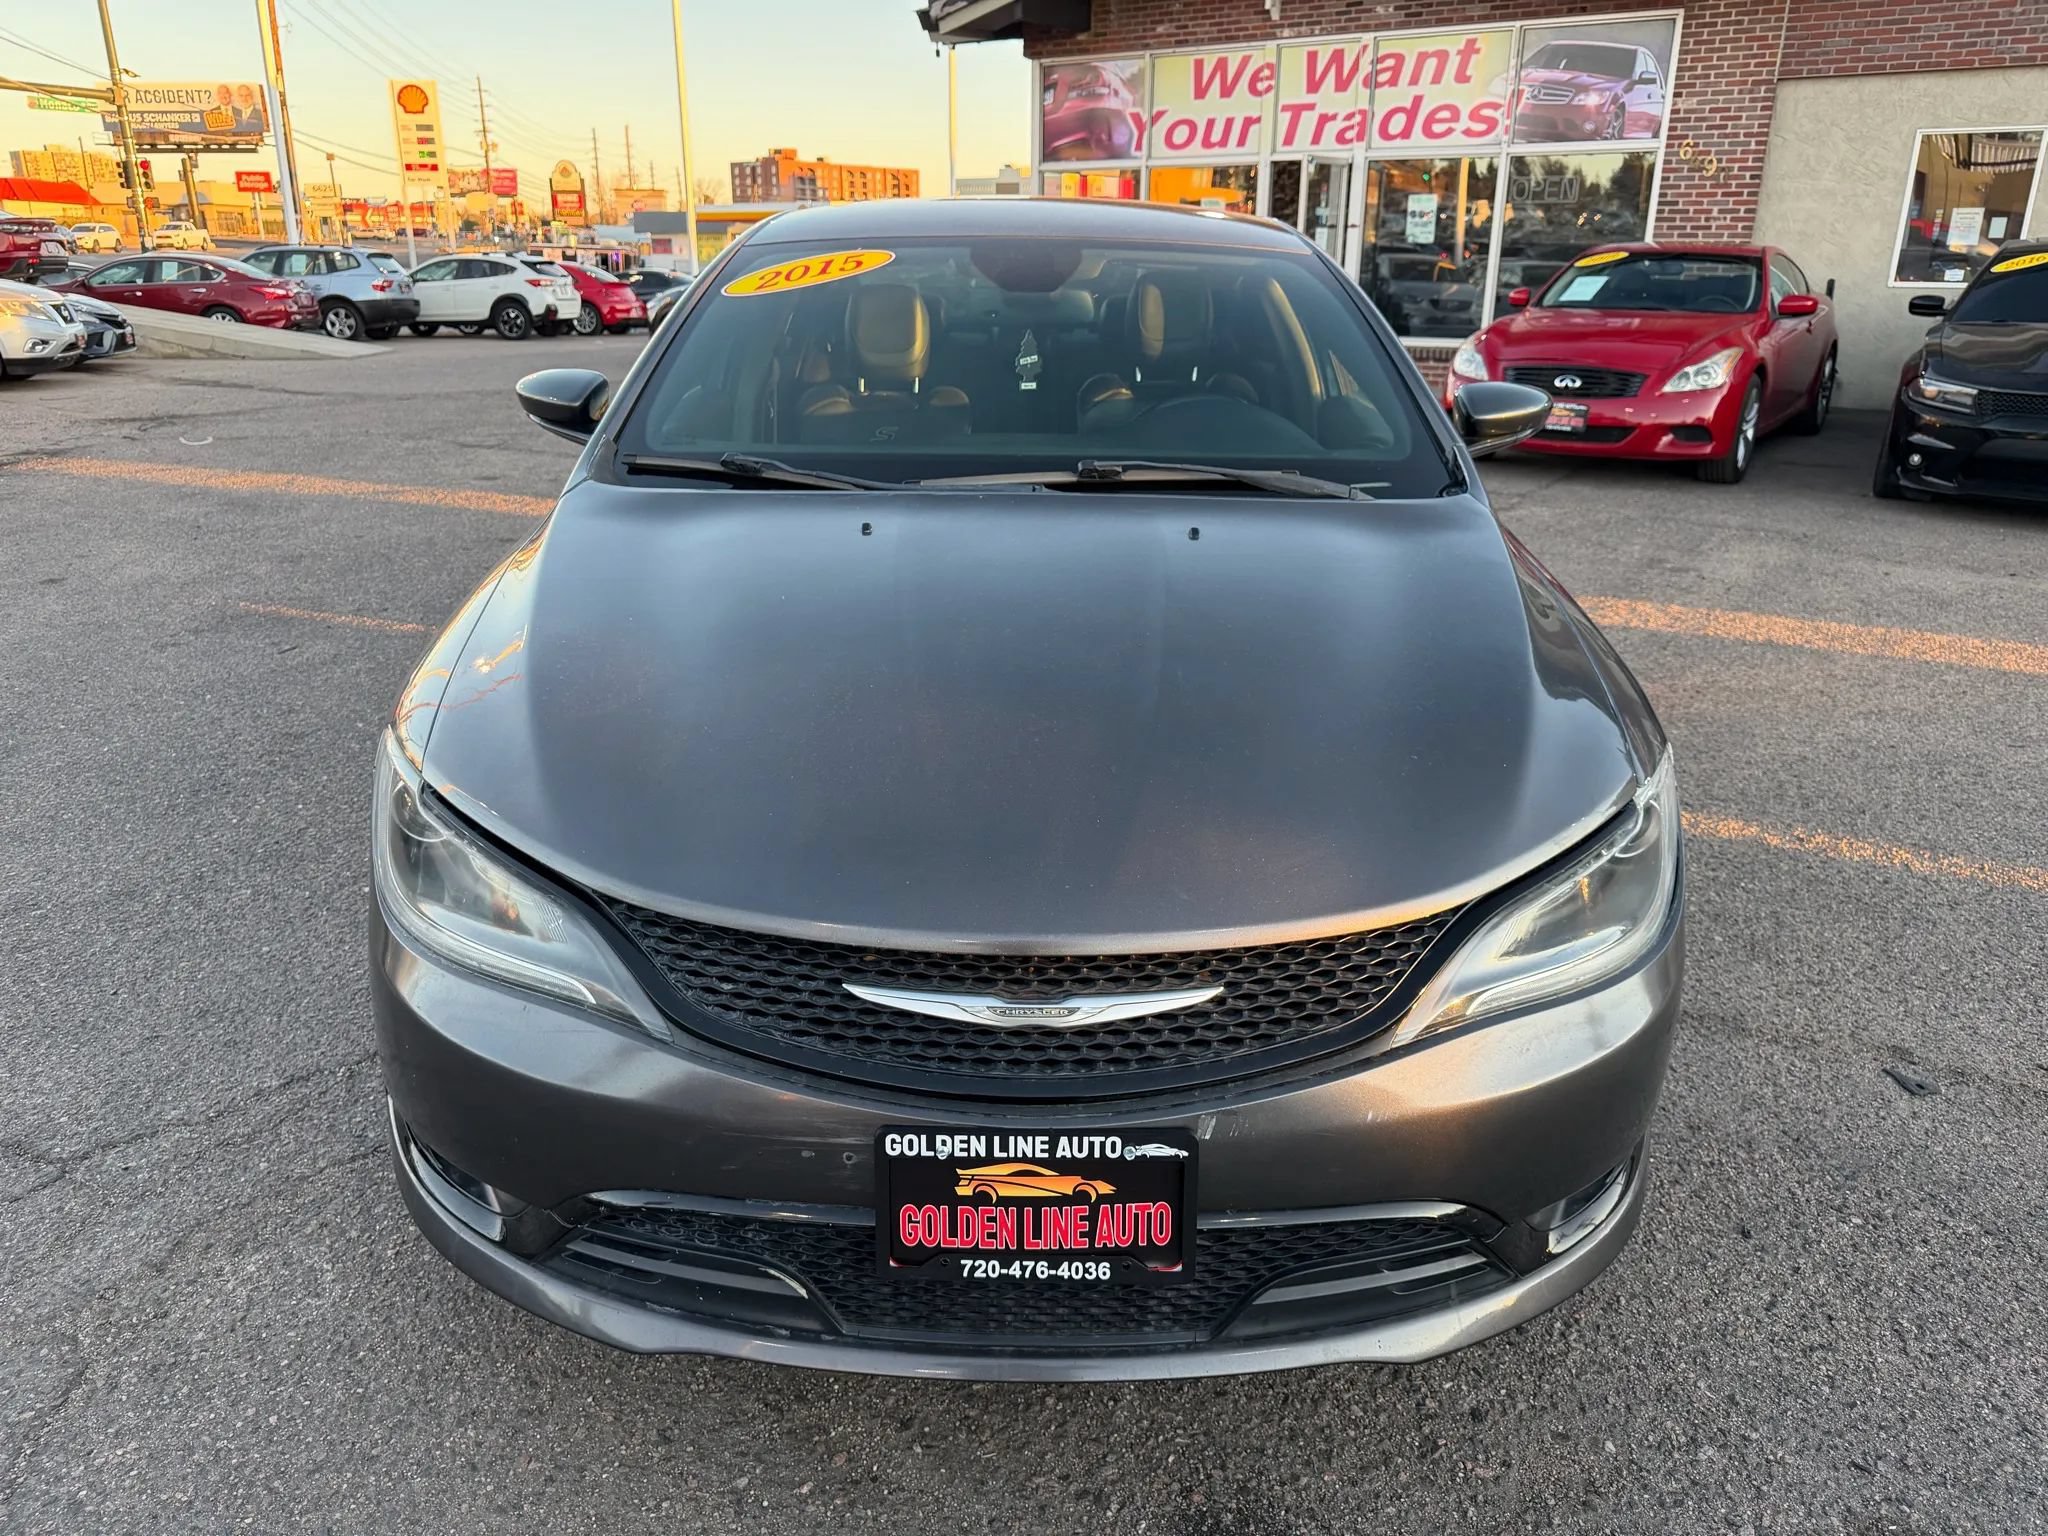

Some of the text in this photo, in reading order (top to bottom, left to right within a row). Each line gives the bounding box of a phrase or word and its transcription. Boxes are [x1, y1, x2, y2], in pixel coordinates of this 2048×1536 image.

[1193, 37, 1481, 100] We Want
[1128, 88, 1526, 152] Your Trades!
[1512, 177, 1577, 201] OPEN
[754, 253, 865, 291] 2015
[885, 1133, 1122, 1159] GOLDEN LINE AUTO
[900, 1201, 1172, 1250] GOLDEN LINE AUTO
[961, 1259, 1111, 1280] 720-476-4036
